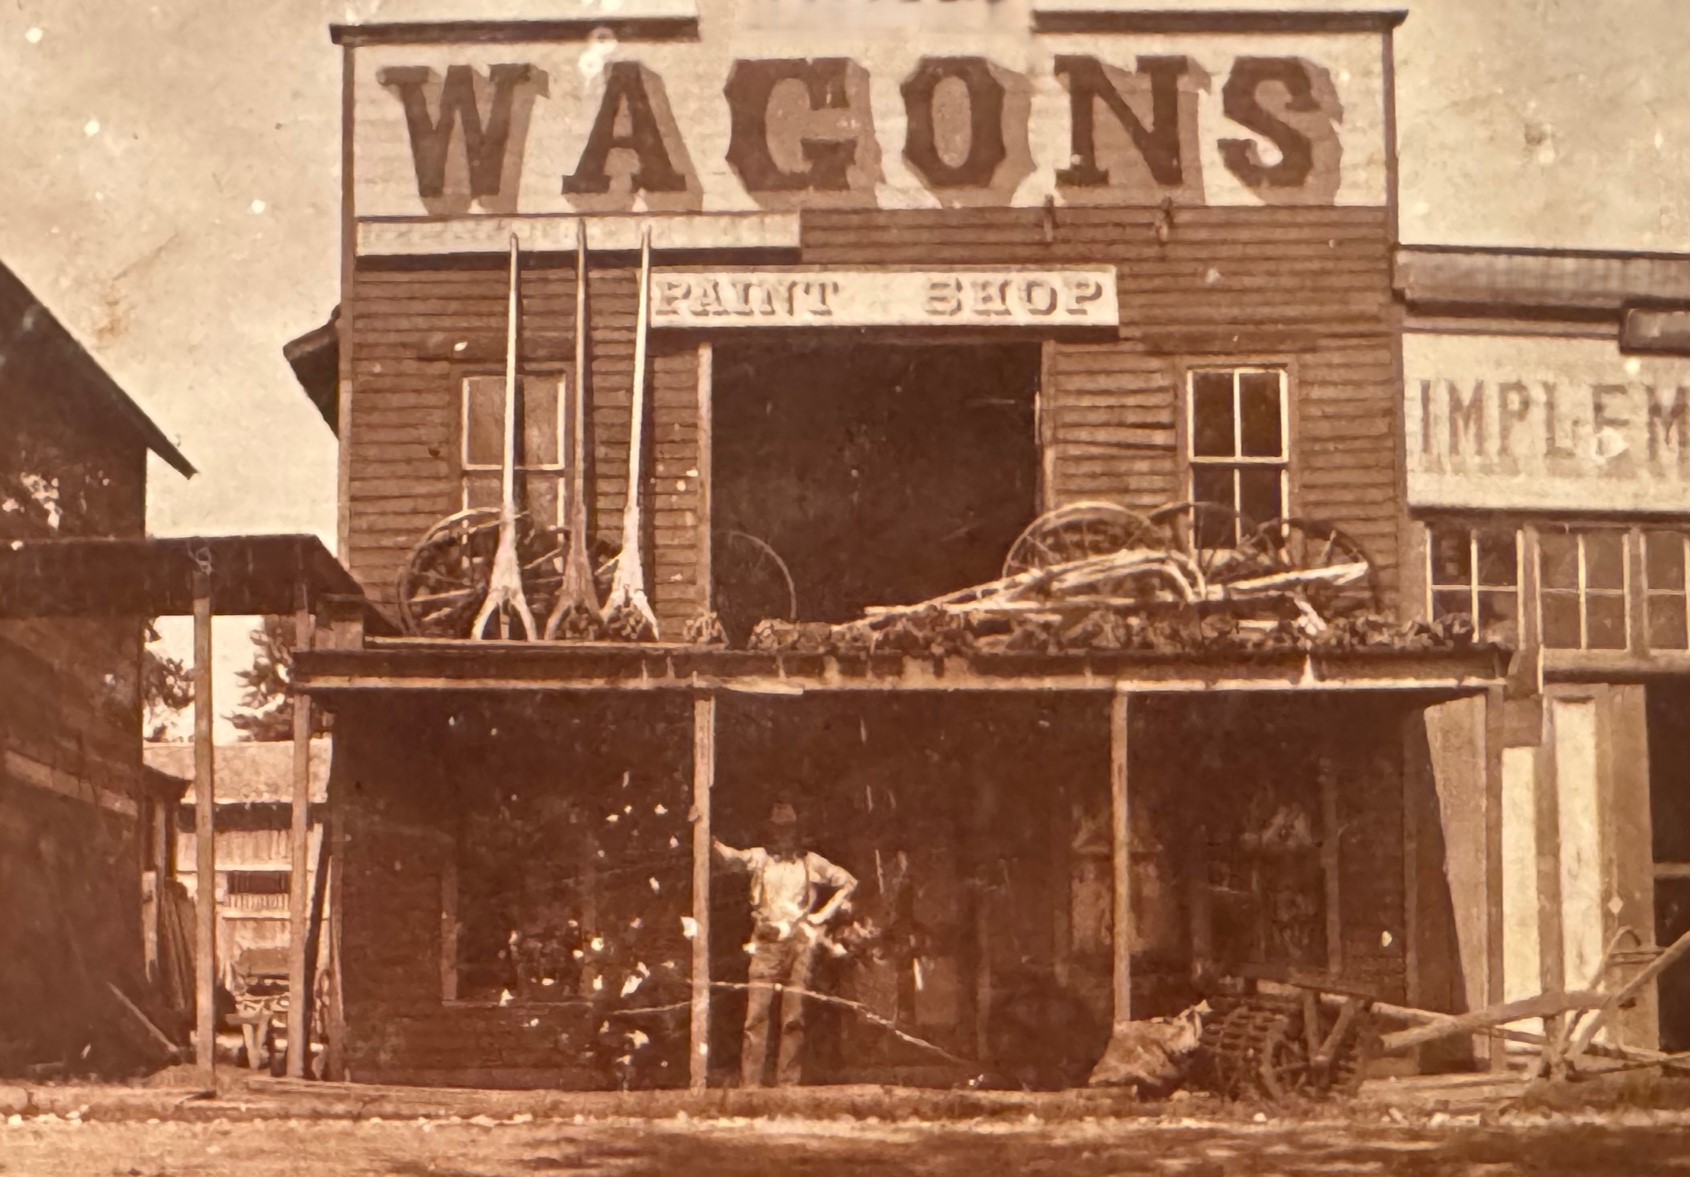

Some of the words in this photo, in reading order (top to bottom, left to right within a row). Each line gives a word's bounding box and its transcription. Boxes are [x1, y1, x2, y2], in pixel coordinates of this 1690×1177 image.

[377, 56, 1343, 212] WAGONS
[654, 277, 839, 317] PAINT
[924, 277, 1104, 316] SHOP
